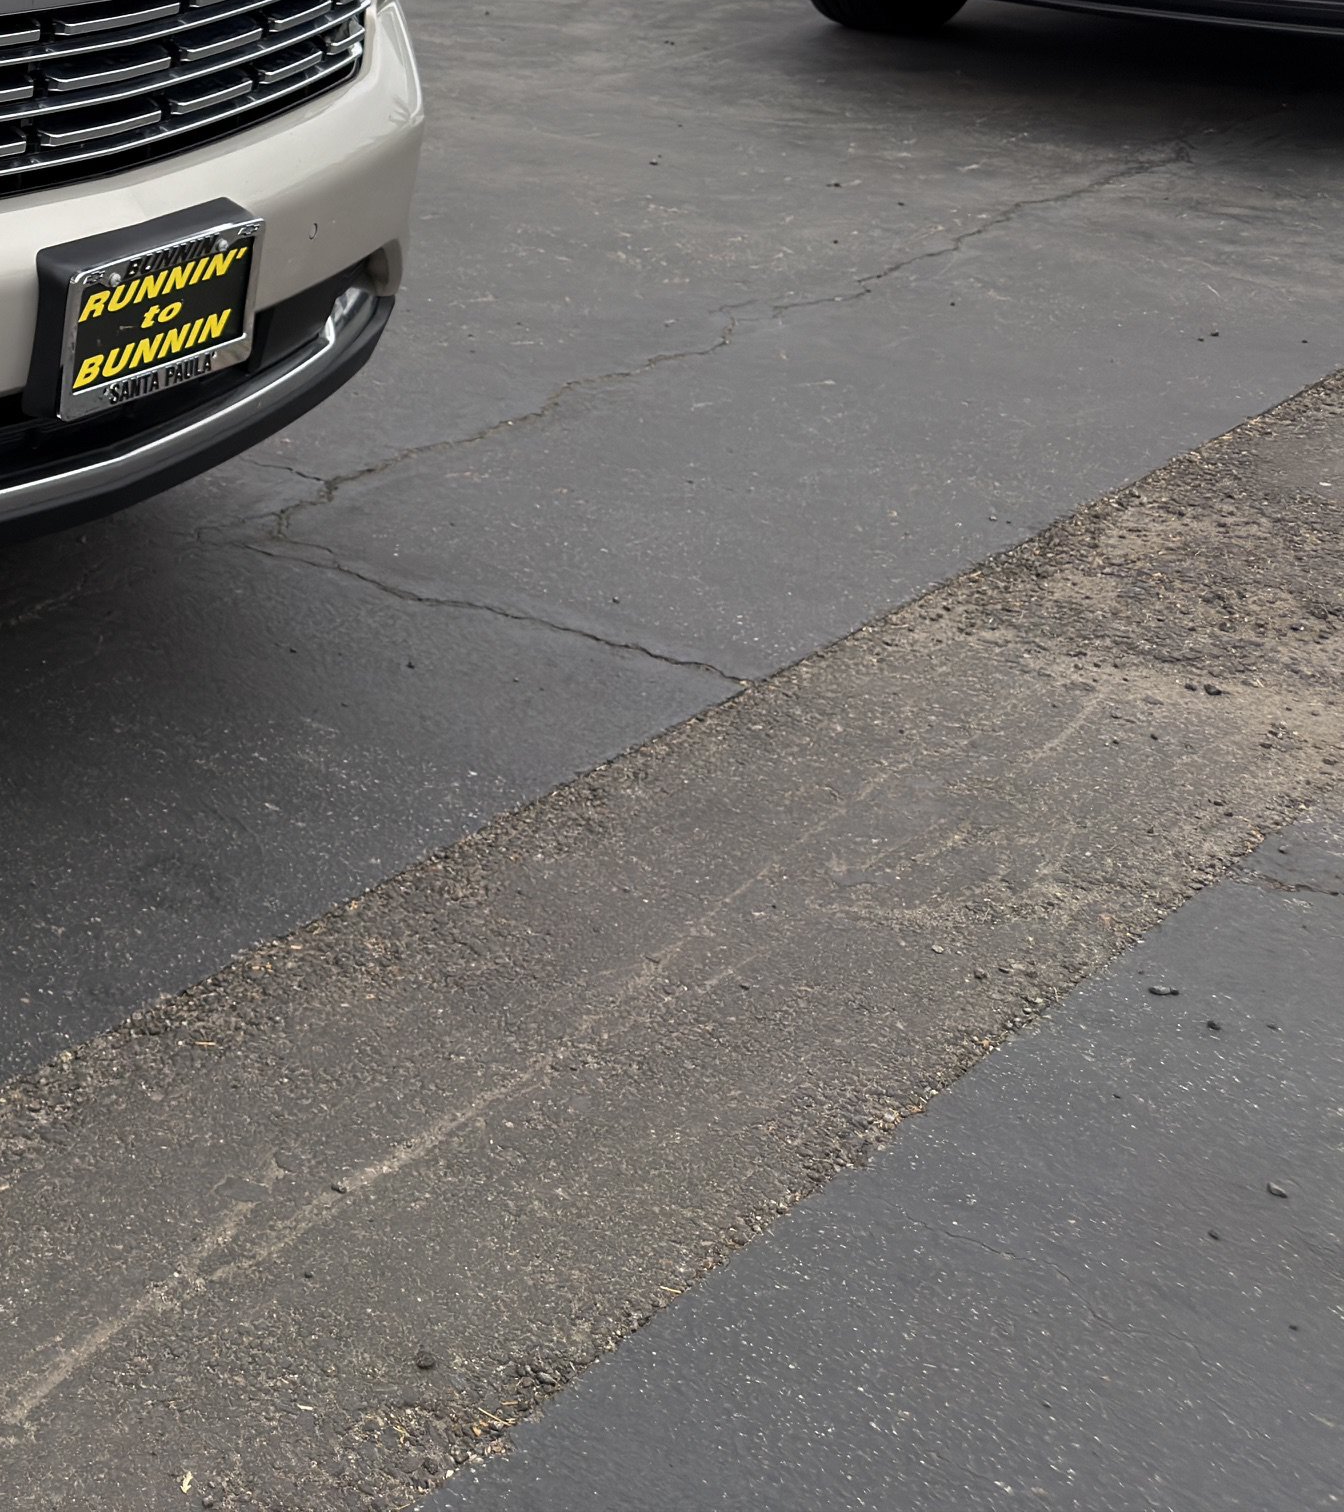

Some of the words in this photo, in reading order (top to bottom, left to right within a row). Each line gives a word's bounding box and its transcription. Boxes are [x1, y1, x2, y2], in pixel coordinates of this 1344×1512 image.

[125, 233, 220, 277] BUNNIN
[78, 247, 248, 323] RUNNIN'
[141, 302, 182, 329] to
[72, 308, 232, 388] BUNNIN
[110, 371, 160, 404] SANTA
[165, 353, 212, 386] PAULA
